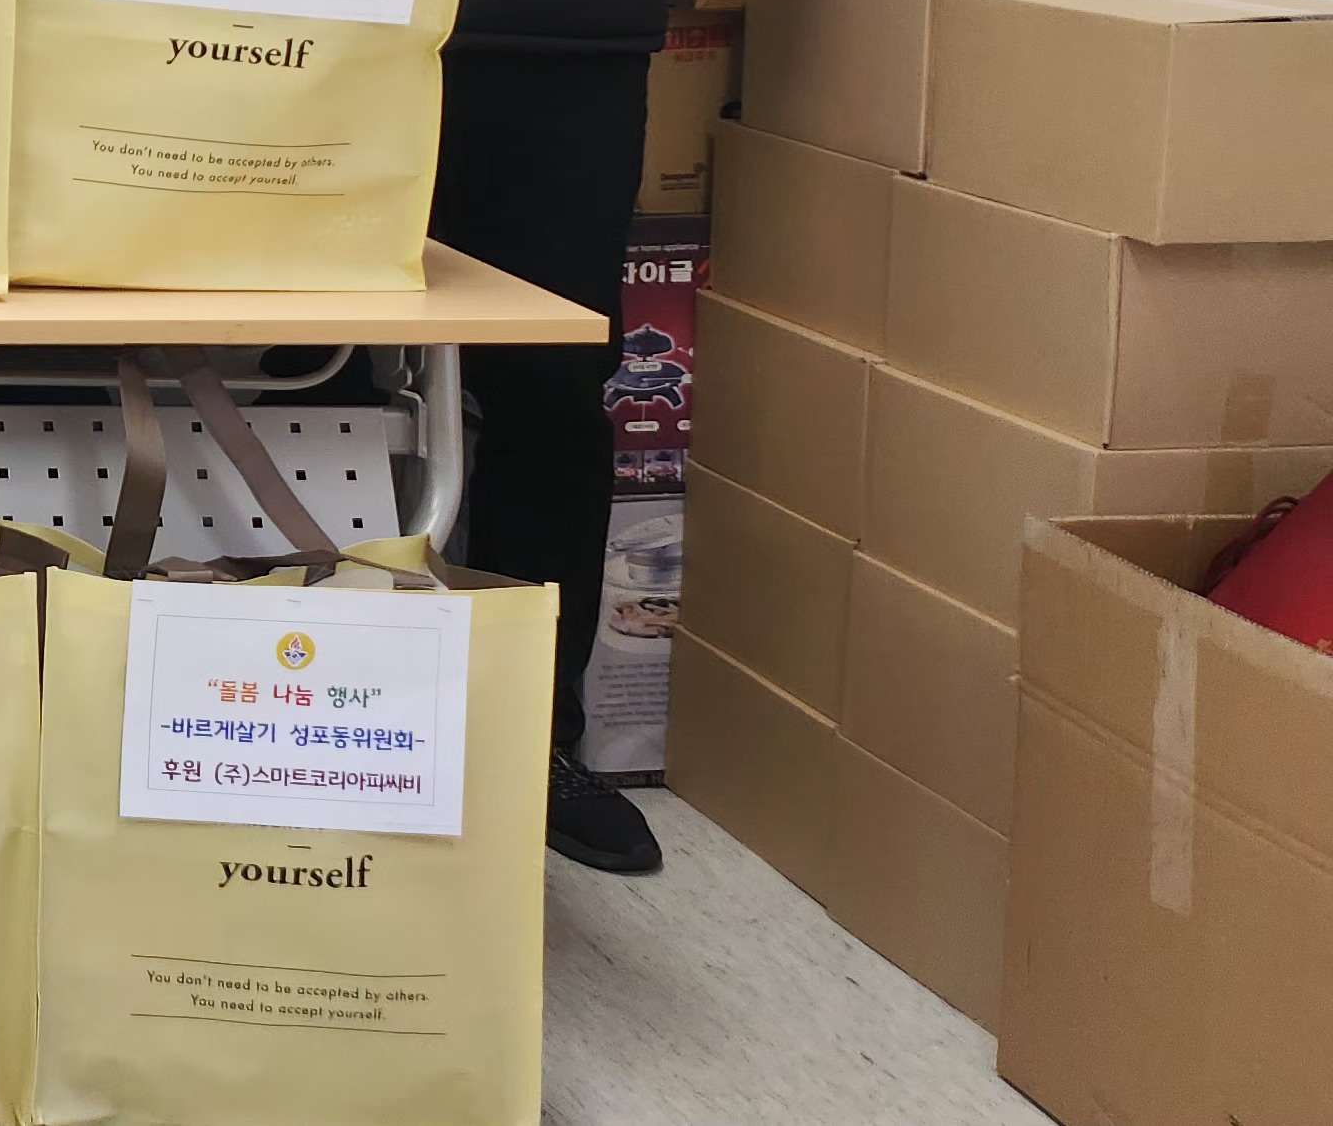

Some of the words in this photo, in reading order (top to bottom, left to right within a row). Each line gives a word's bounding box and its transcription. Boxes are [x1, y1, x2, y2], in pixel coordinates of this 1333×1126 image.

[166, 37, 315, 69] yourself
[272, 683, 314, 707] 나눔
[161, 758, 202, 783] 후원
[214, 761, 421, 795] (주)스마트코리아피씨비
[217, 854, 374, 889] yourself
